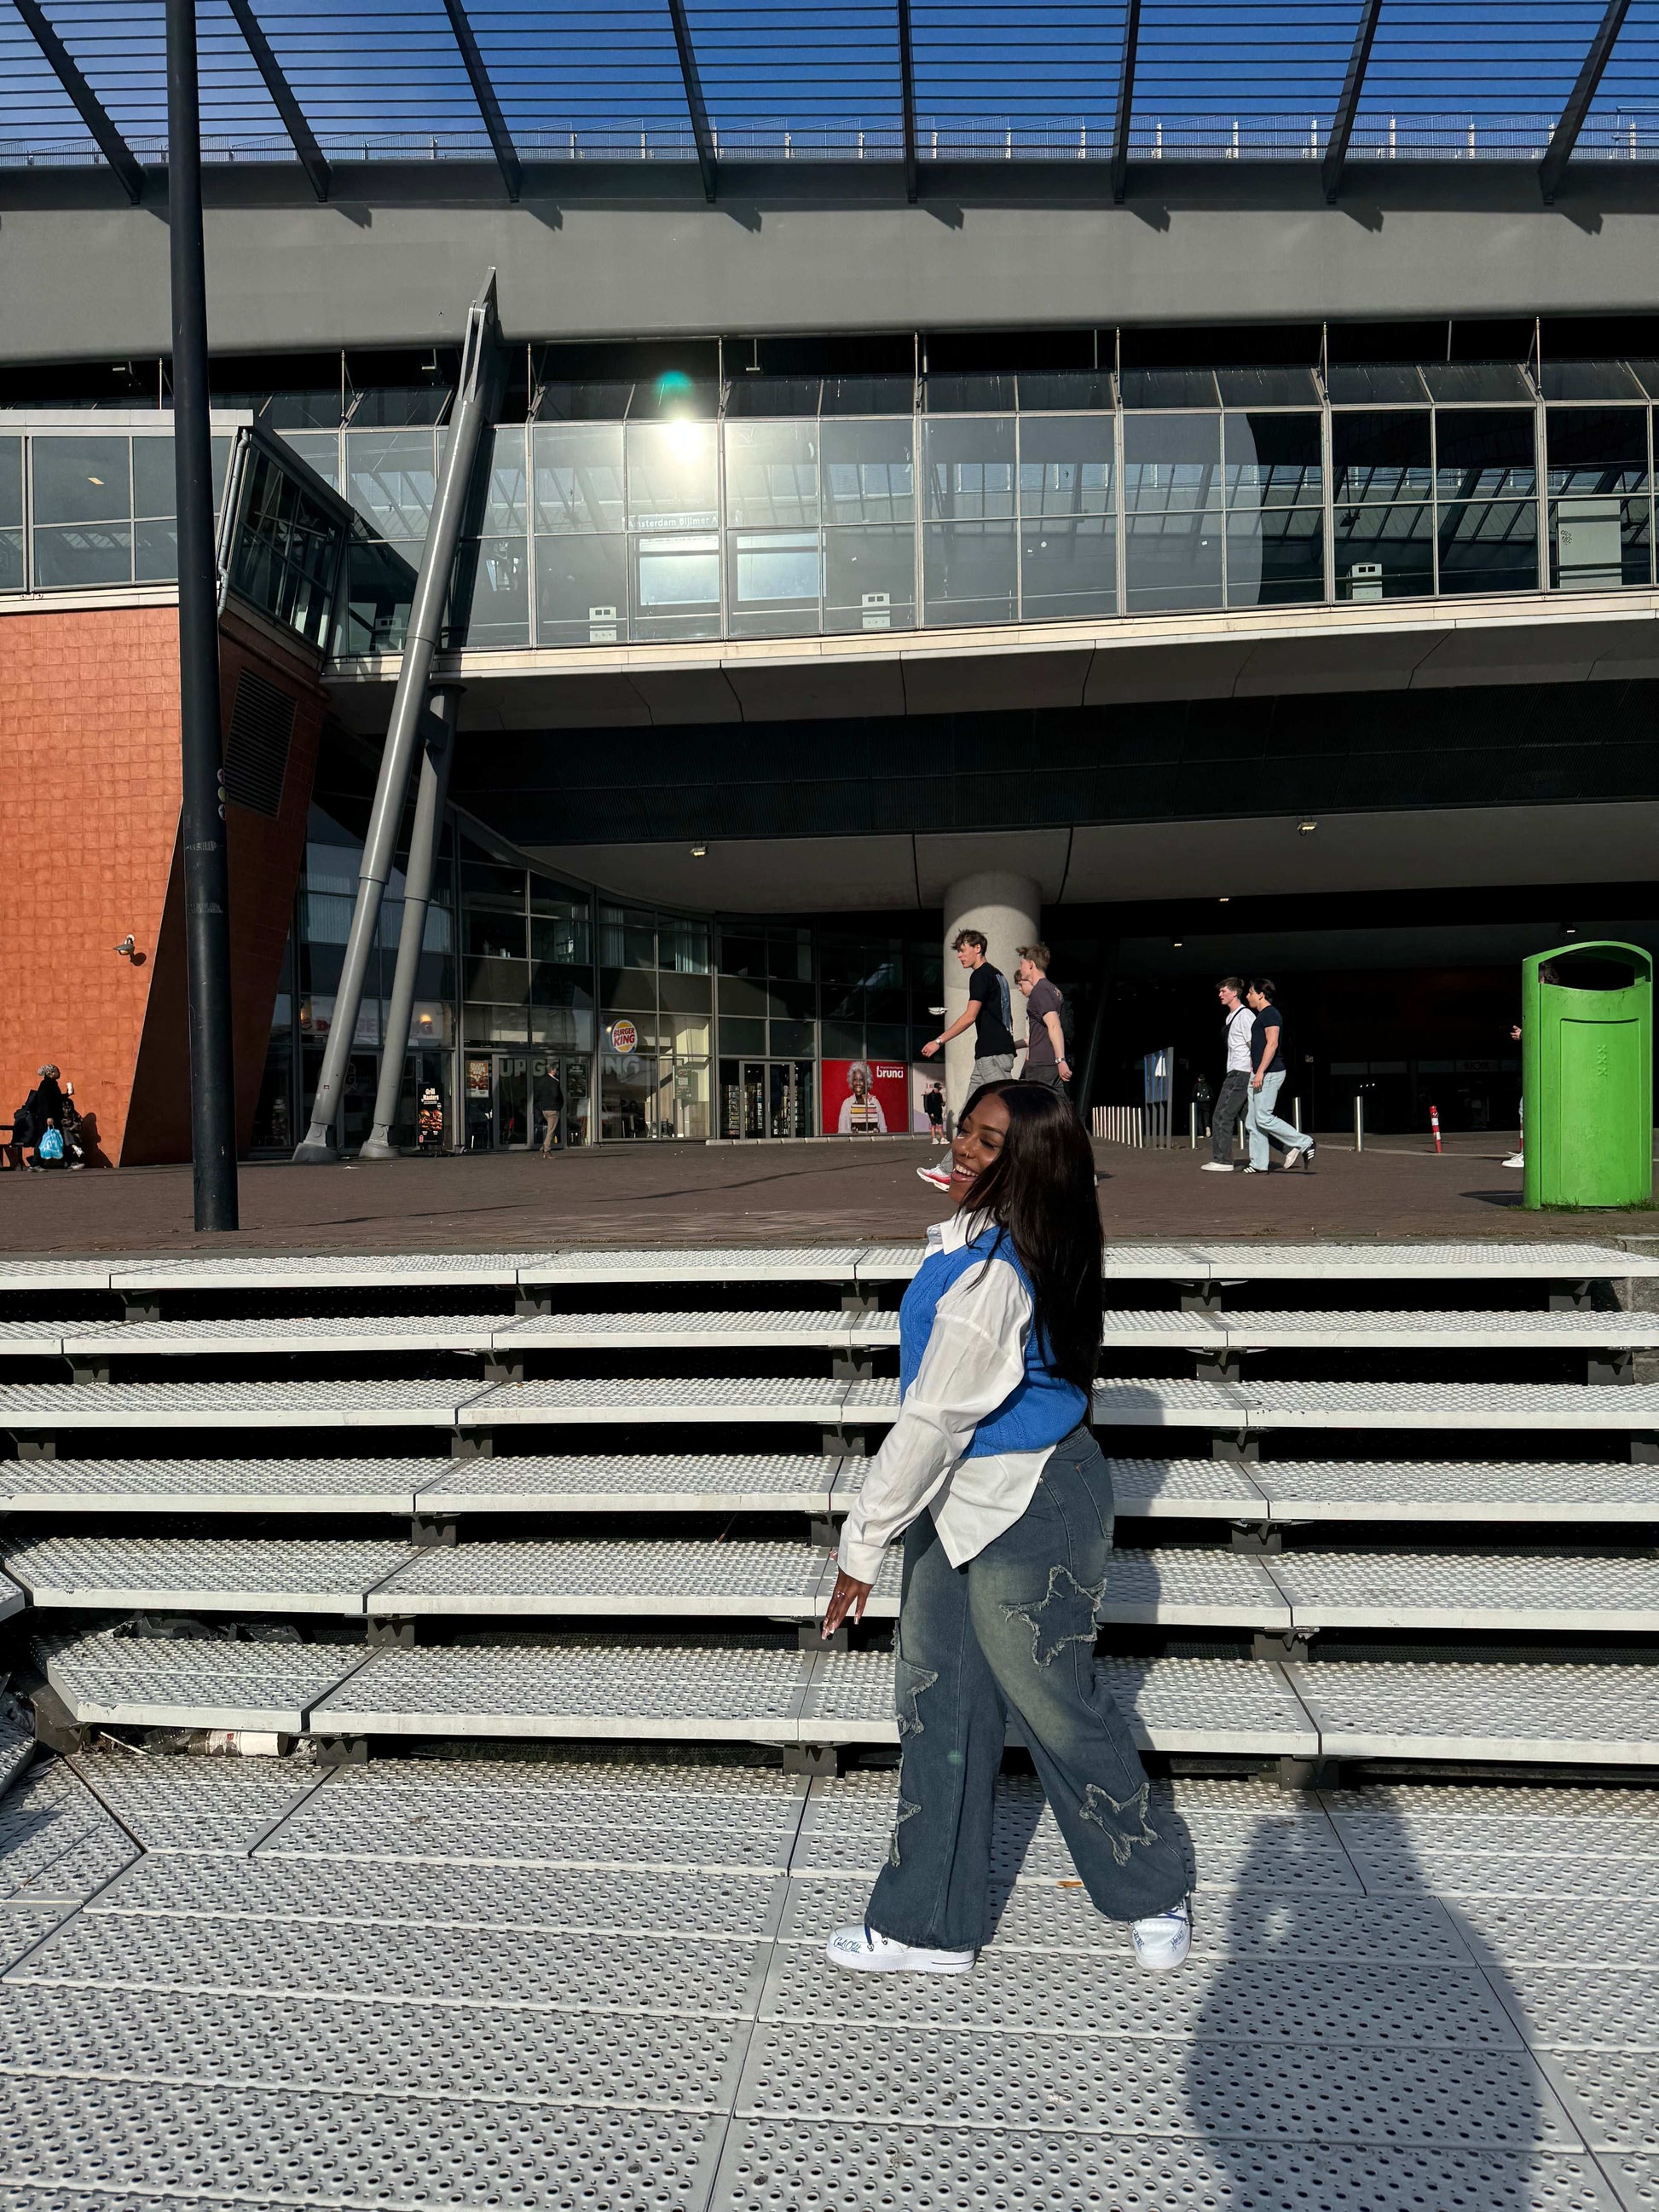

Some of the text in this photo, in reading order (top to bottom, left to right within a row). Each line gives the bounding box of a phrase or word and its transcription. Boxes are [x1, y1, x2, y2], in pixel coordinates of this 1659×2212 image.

[679, 517, 709, 527] Bijlmer
[614, 1027, 635, 1037] BURGER
[614, 1034, 635, 1047] KING
[876, 1066, 904, 1078] bruna
